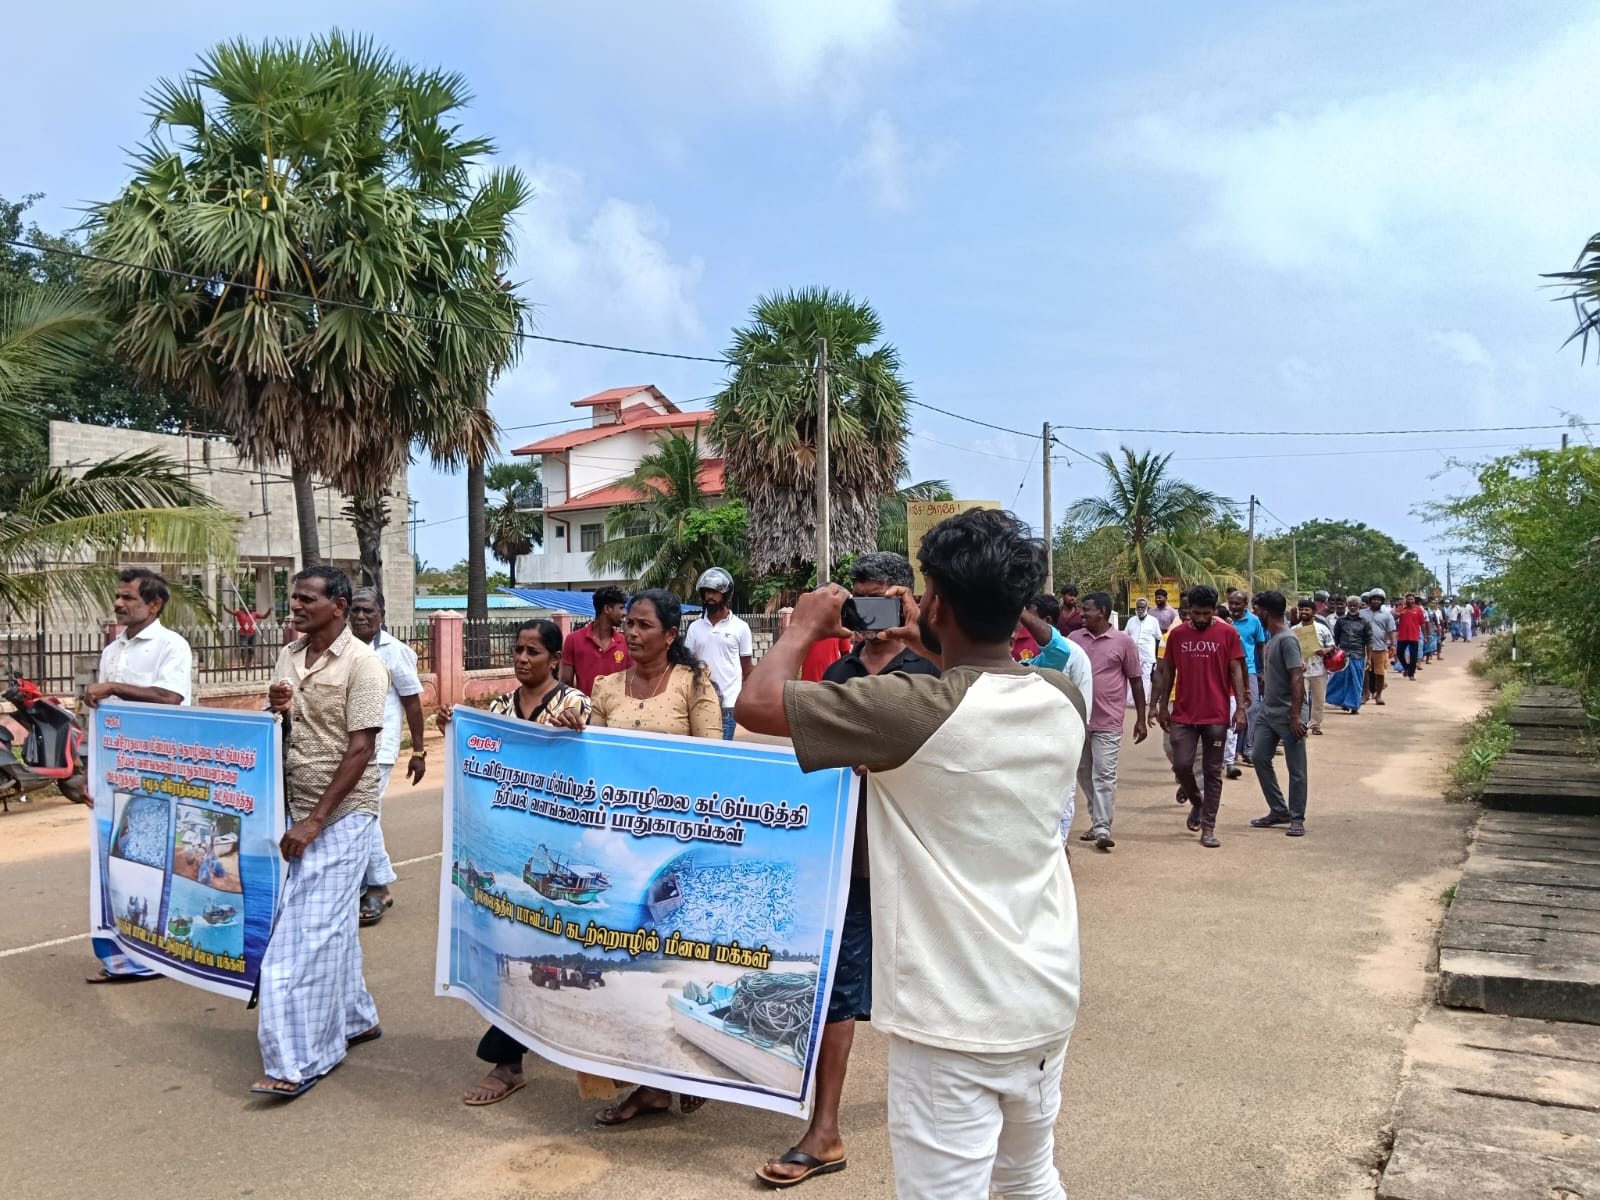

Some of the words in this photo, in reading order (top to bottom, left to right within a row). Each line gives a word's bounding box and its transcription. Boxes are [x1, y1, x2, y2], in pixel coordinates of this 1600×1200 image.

[1181, 641, 1220, 653] SLOW
[467, 735, 502, 752] அரசே!
[463, 756, 544, 789] சட்டவிரோதமான
[545, 769, 597, 803] மீன்பிடித்
[600, 784, 690, 813] தொழிலை
[694, 792, 810, 829] கட்டுப்படுத்தி
[492, 785, 530, 810] நீரியல்
[530, 797, 608, 827] வளங்களைப்
[611, 817, 746, 845] பாதுகாருங்கள்
[515, 904, 563, 935] மாவட்டம்
[664, 931, 712, 960] மீனவ
[715, 941, 772, 969] மக்கள்
